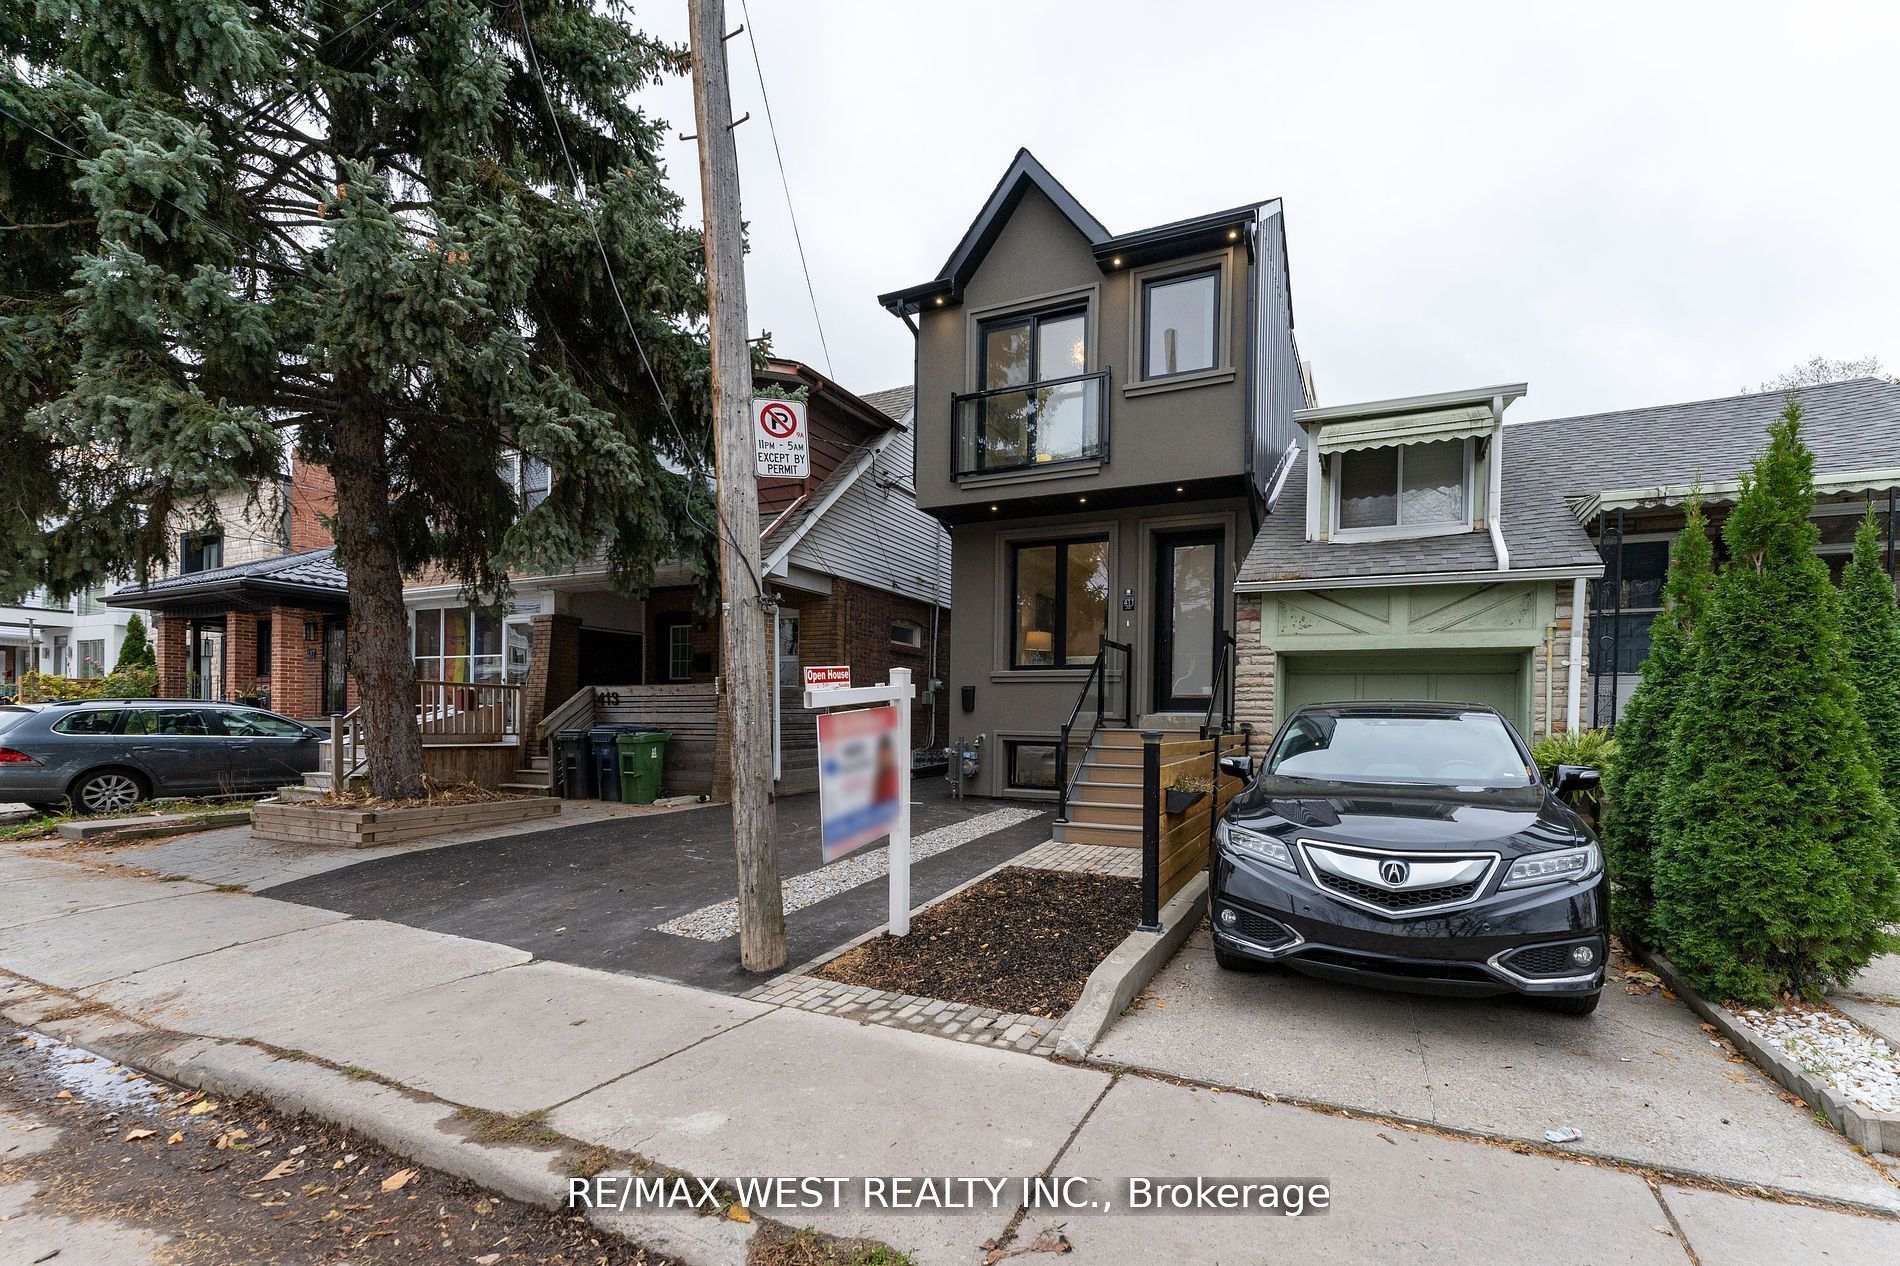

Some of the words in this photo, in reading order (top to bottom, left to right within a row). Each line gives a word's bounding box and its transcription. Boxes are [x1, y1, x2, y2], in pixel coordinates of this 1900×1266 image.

[758, 440, 775, 449] 11PM
[787, 441, 804, 451] 5AM
[758, 452, 790, 463] EXCEPT
[794, 455, 805, 464] BY
[767, 464, 798, 475] PERMIT
[807, 669, 826, 683] Open
[827, 669, 849, 680] House
